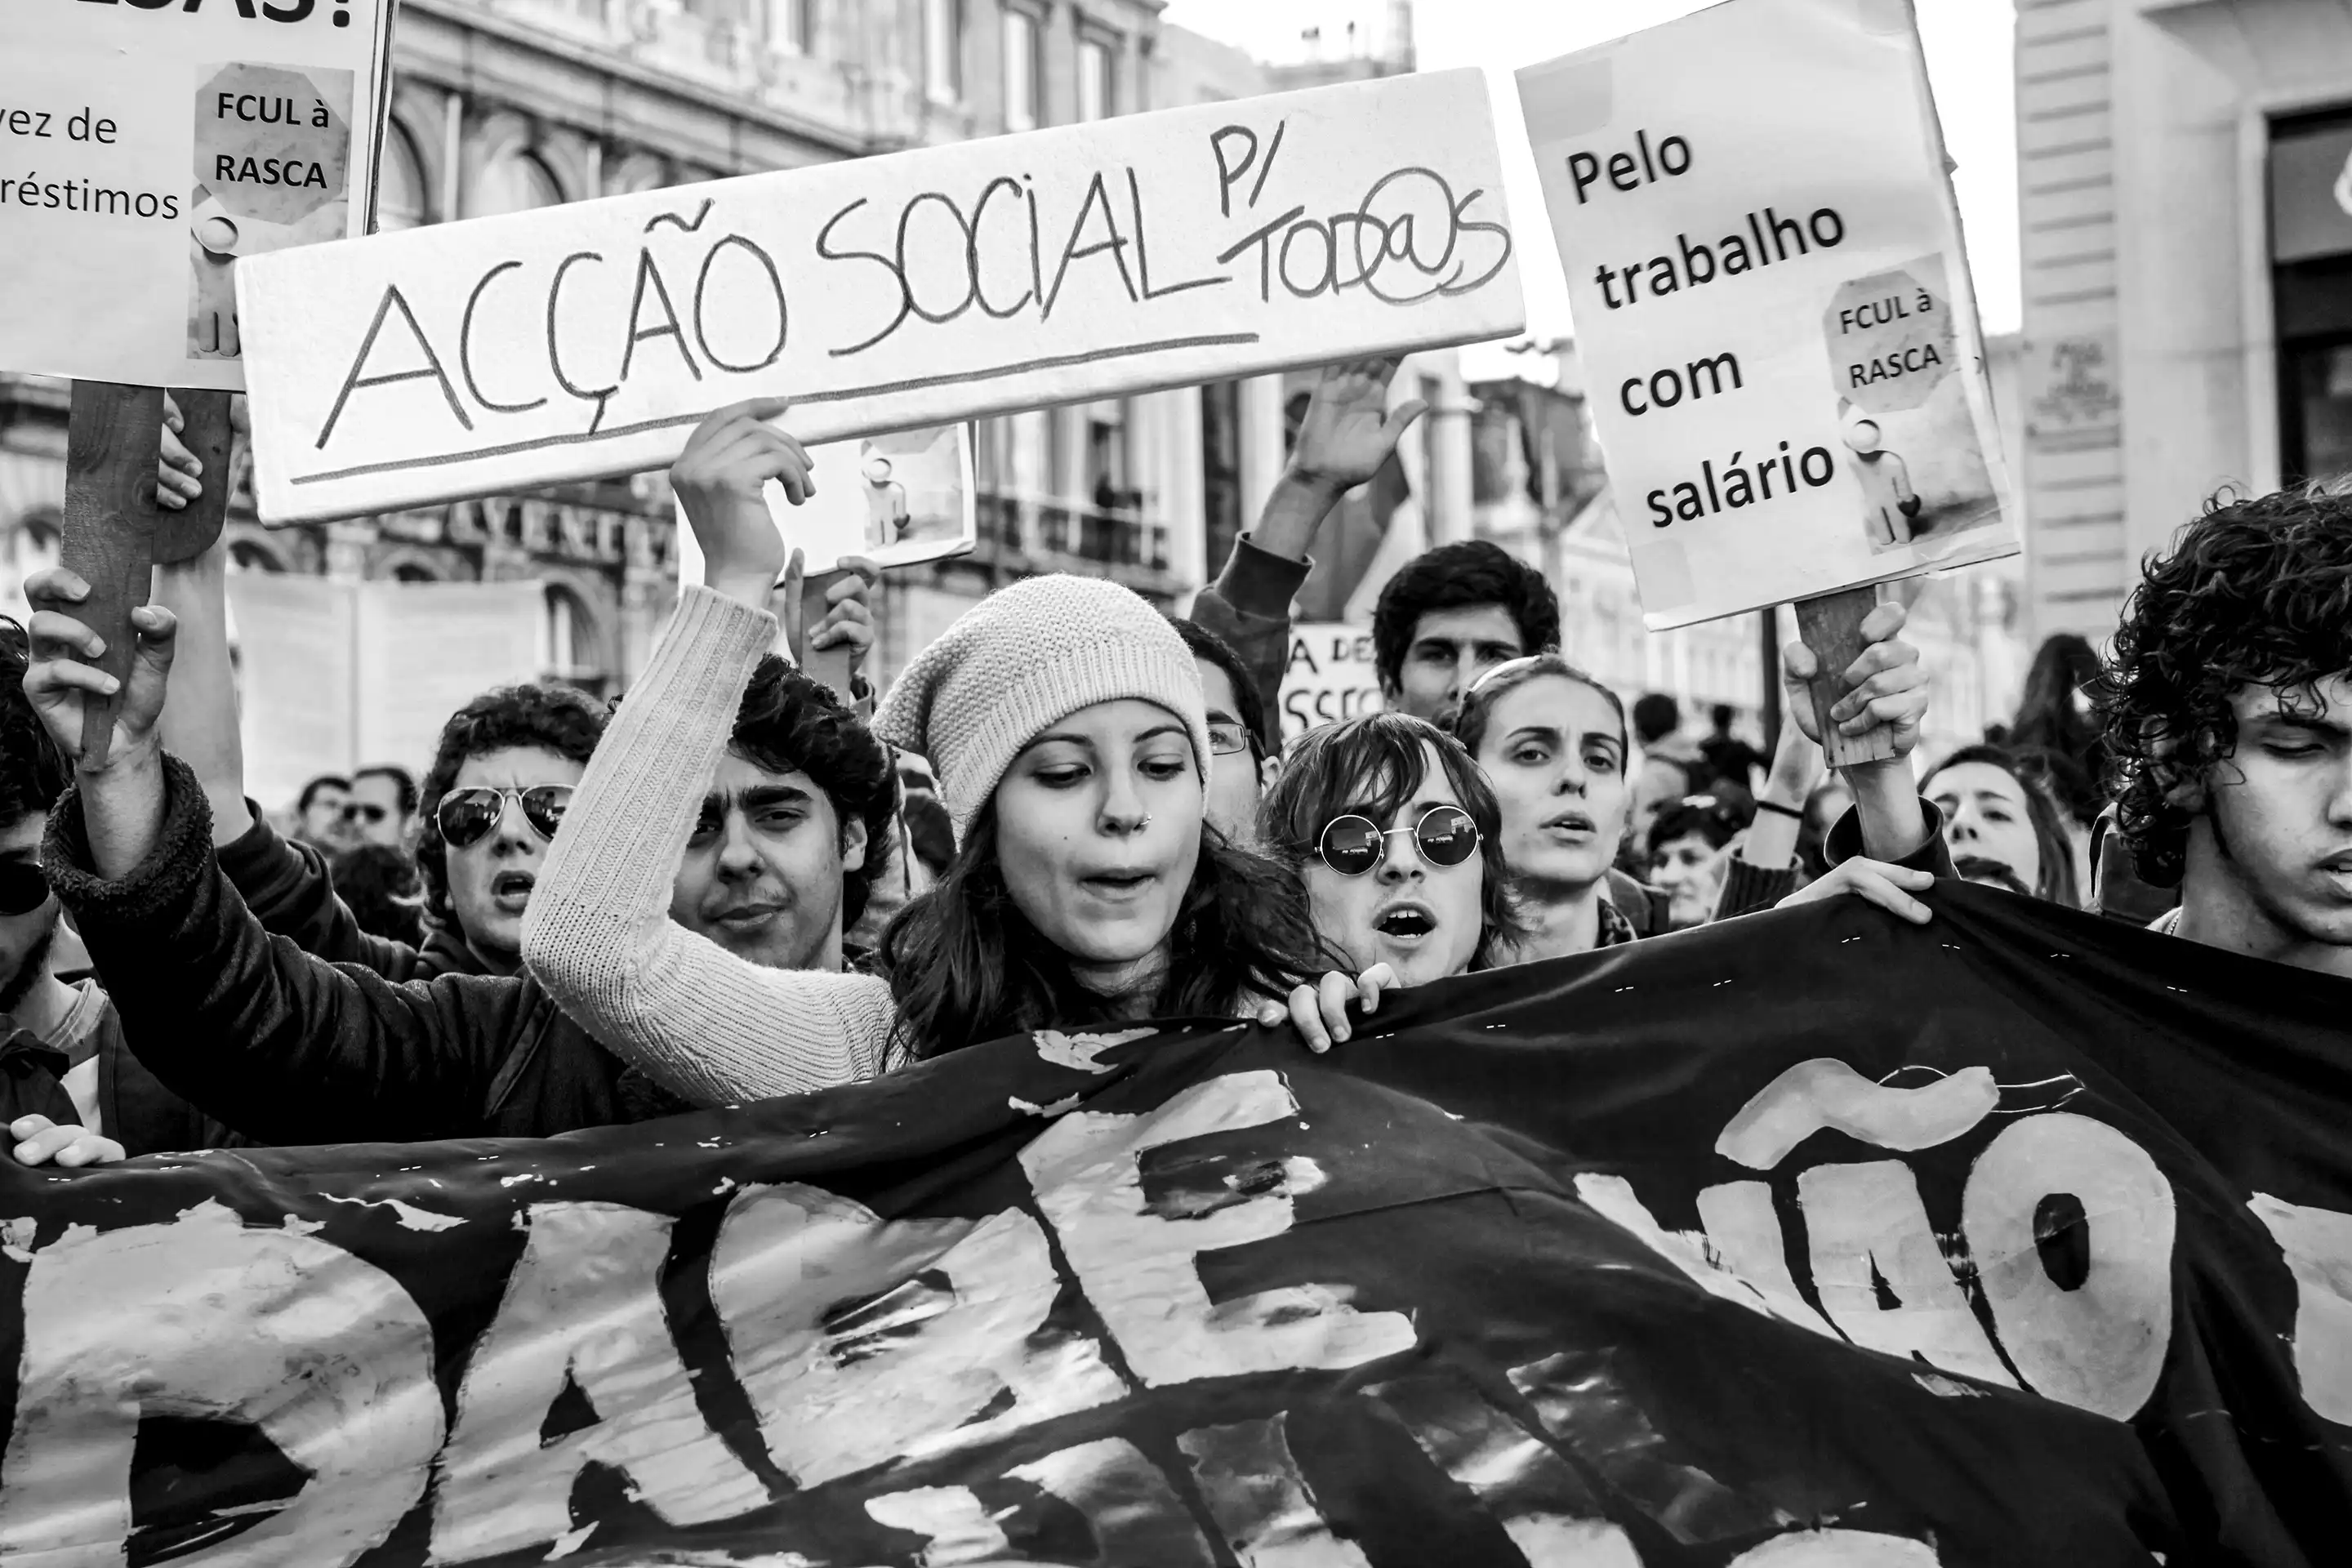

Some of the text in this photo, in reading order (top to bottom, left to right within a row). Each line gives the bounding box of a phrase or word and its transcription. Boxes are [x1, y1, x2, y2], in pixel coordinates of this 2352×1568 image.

[67, 105, 118, 145] de
[217, 91, 330, 129] FCUL à
[0, 170, 180, 220] réstimos
[215, 154, 328, 190] RASCA
[1209, 119, 1286, 218] P/
[1566, 127, 1693, 206] Pelo
[1595, 206, 1846, 310] trabalho
[315, 198, 788, 450] ACÇÃO
[1839, 287, 1934, 335] FCUL à
[1619, 350, 1744, 417] com
[1848, 343, 1943, 390] RASCA
[1646, 439, 1835, 529] salário
